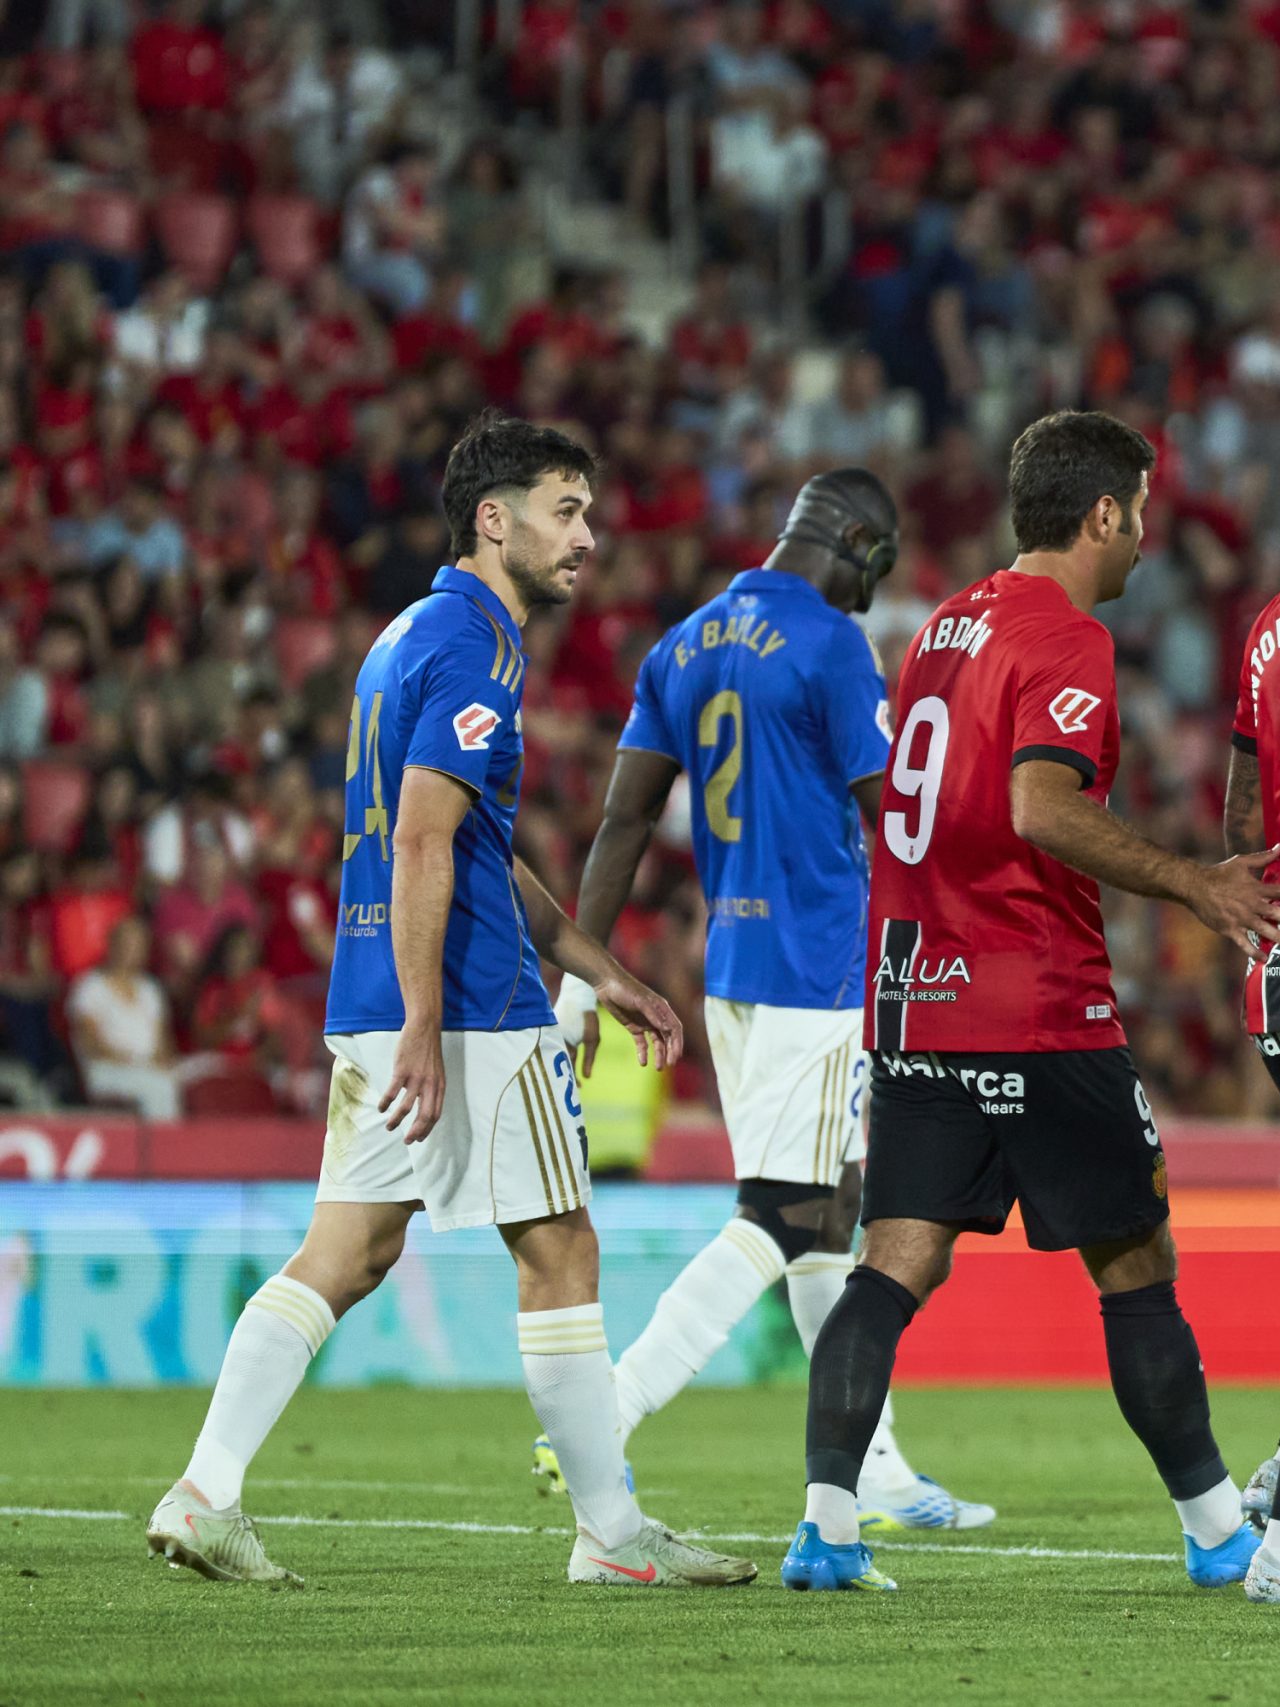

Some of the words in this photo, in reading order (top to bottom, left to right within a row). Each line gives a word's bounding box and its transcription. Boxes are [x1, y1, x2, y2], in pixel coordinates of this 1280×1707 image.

[701, 614, 786, 658] BAILLY
[916, 609, 993, 660] ABDÓN
[699, 689, 743, 844] 2
[883, 695, 950, 866] 9
[872, 955, 971, 984] ALUA
[878, 990, 908, 1001] HOTELS
[909, 991, 916, 1001] &
[917, 991, 957, 1002] RESORTS
[1134, 1080, 1158, 1146] 9
